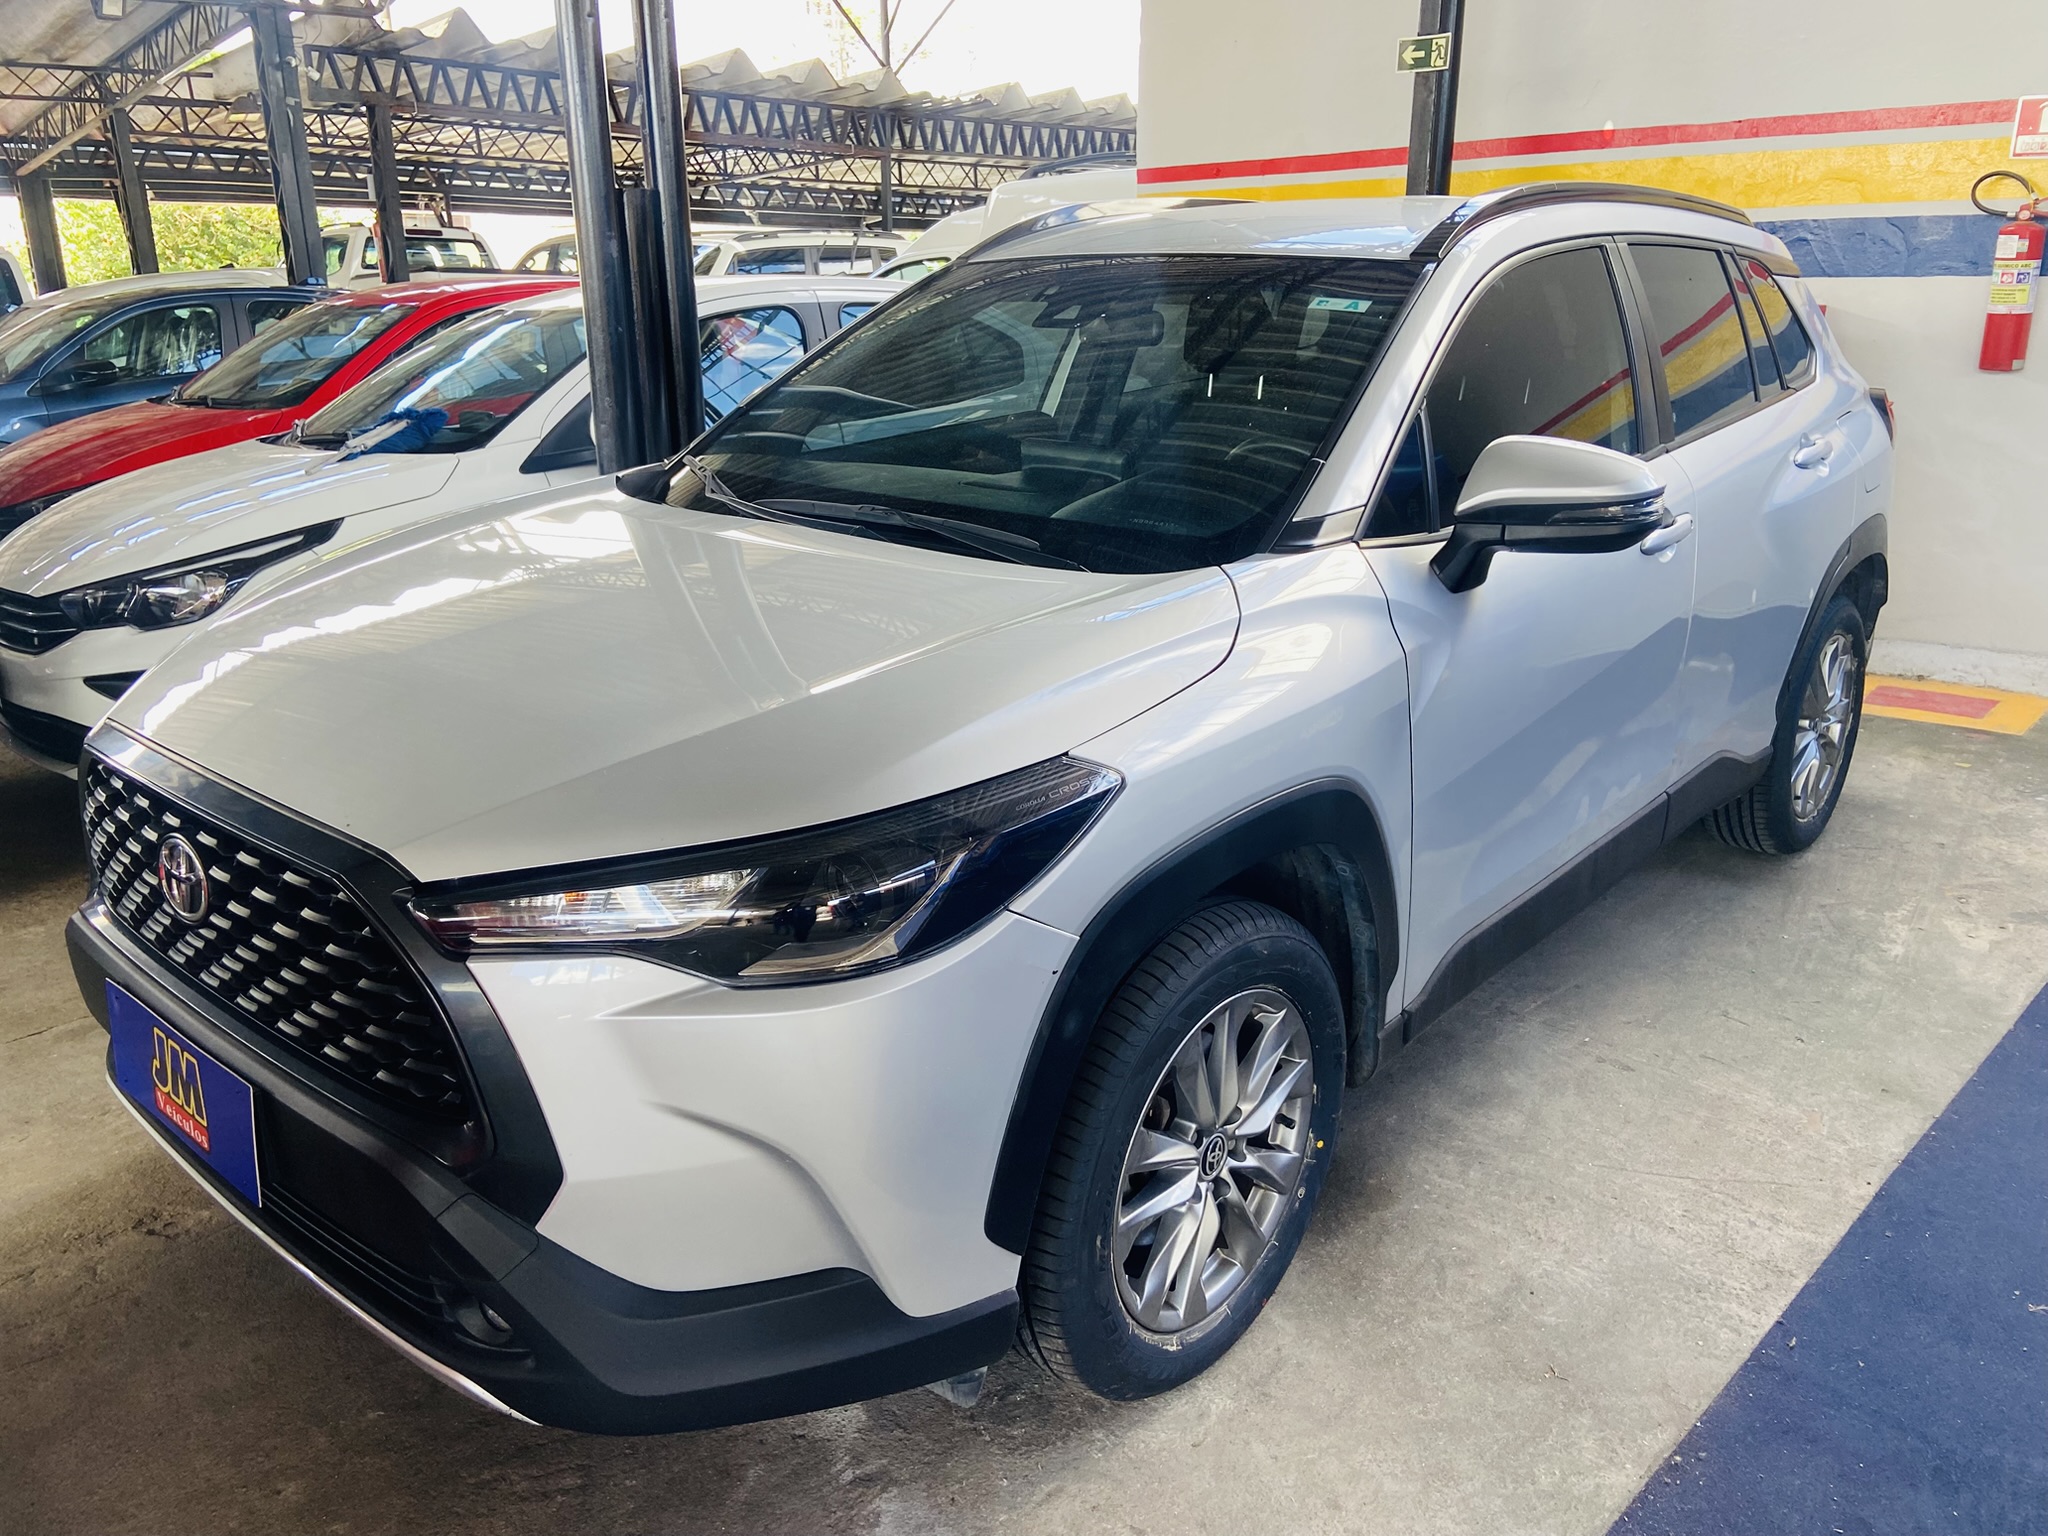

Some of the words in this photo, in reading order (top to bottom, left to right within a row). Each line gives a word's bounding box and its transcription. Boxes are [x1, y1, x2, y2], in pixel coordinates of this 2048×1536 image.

[1015, 796, 1046, 811] COROLLA
[1048, 774, 1102, 799] CROSS
[152, 1026, 208, 1127] JM
